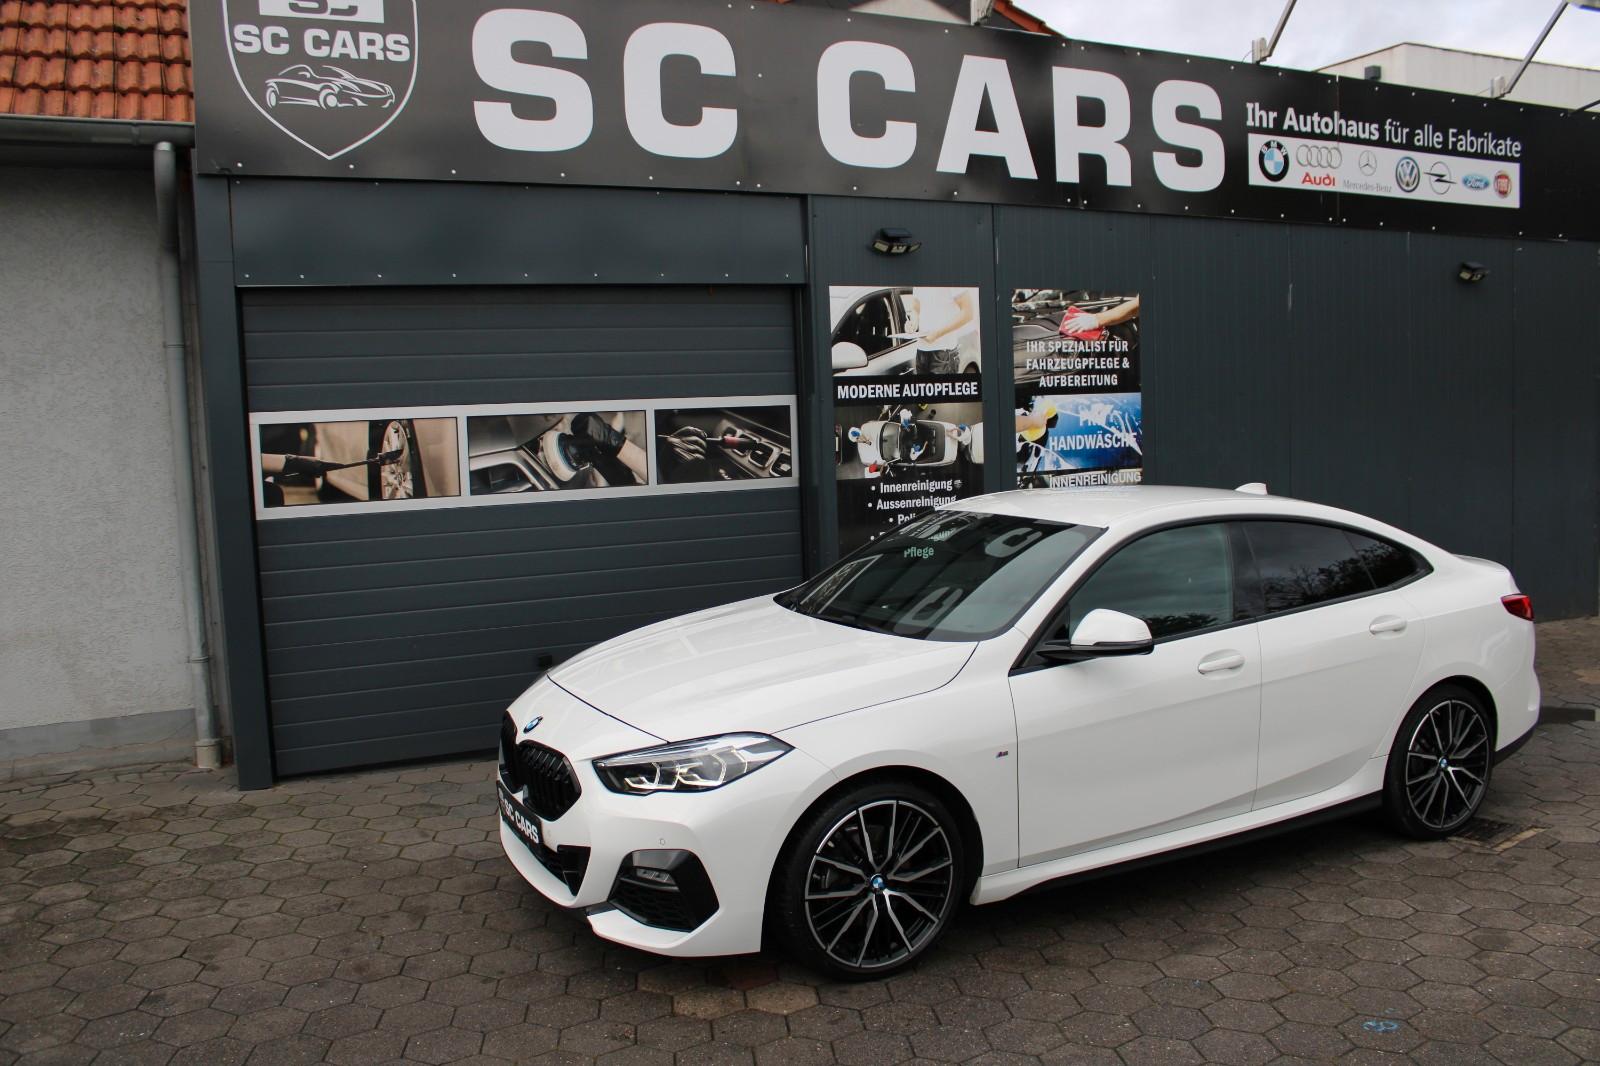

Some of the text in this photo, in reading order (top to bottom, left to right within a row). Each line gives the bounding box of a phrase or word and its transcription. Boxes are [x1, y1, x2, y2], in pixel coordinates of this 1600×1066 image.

[233, 24, 411, 62] SC CARS
[471, 8, 1226, 193] SC CARS
[1246, 102, 1522, 158] Ihr Autohaus für alle Fabrikate
[1301, 172, 1336, 187] Audi
[1026, 338, 1129, 353] IHR SPEZIALIST FÜR
[1026, 357, 1130, 370] FAHRZEUGPFLEGE &
[1039, 374, 1118, 388] AUFBEREITUNG
[837, 382, 979, 399] MODERNE AUTOPFLEGE
[880, 479, 953, 494] Innenreinigung
[1049, 472, 1142, 489] INNENREINIGUNG
[514, 810, 540, 844] CARS
